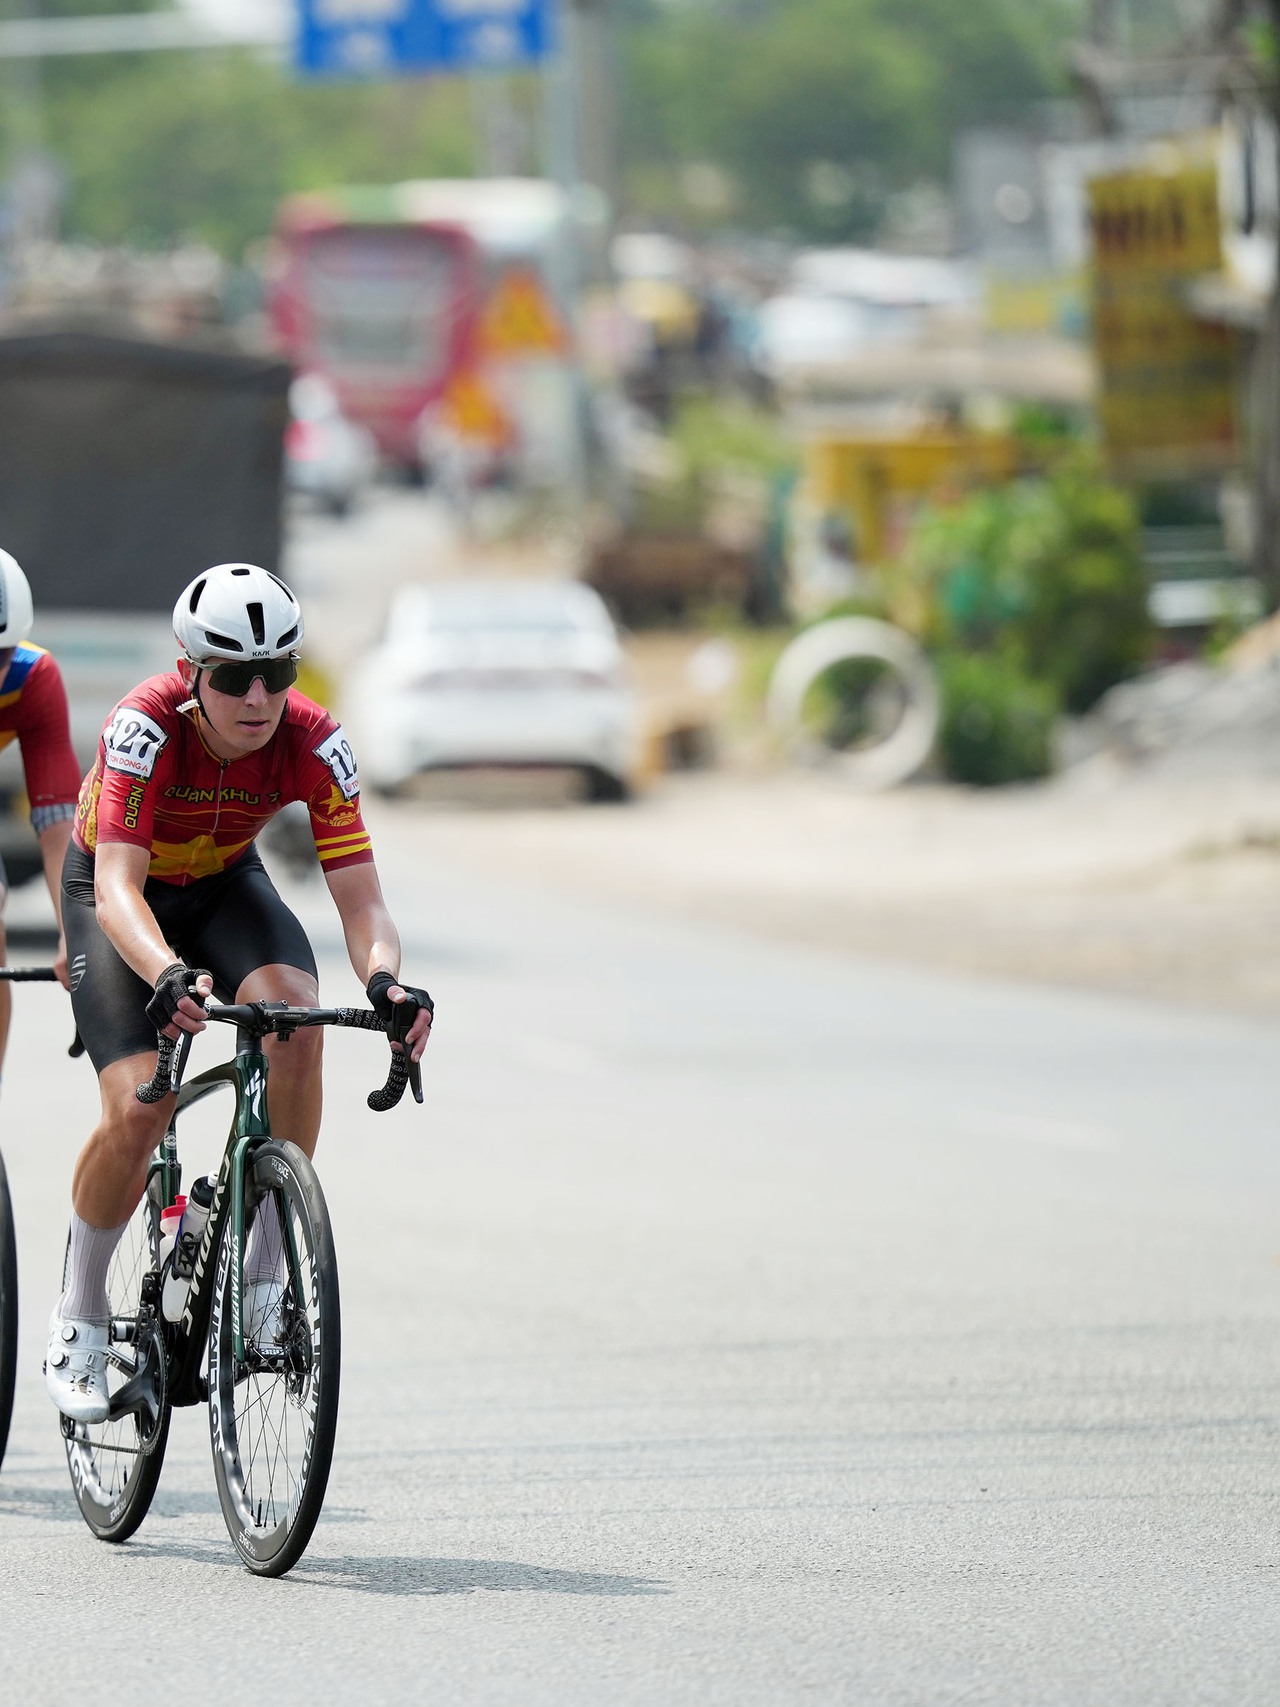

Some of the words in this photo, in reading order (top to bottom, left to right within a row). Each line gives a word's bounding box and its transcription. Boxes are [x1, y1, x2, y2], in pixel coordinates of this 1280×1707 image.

[108, 717, 161, 760] 127
[124, 785, 145, 829] QUÂN
[219, 788, 259, 805] KHU
[231, 1234, 240, 1336] SPECIALIZED
